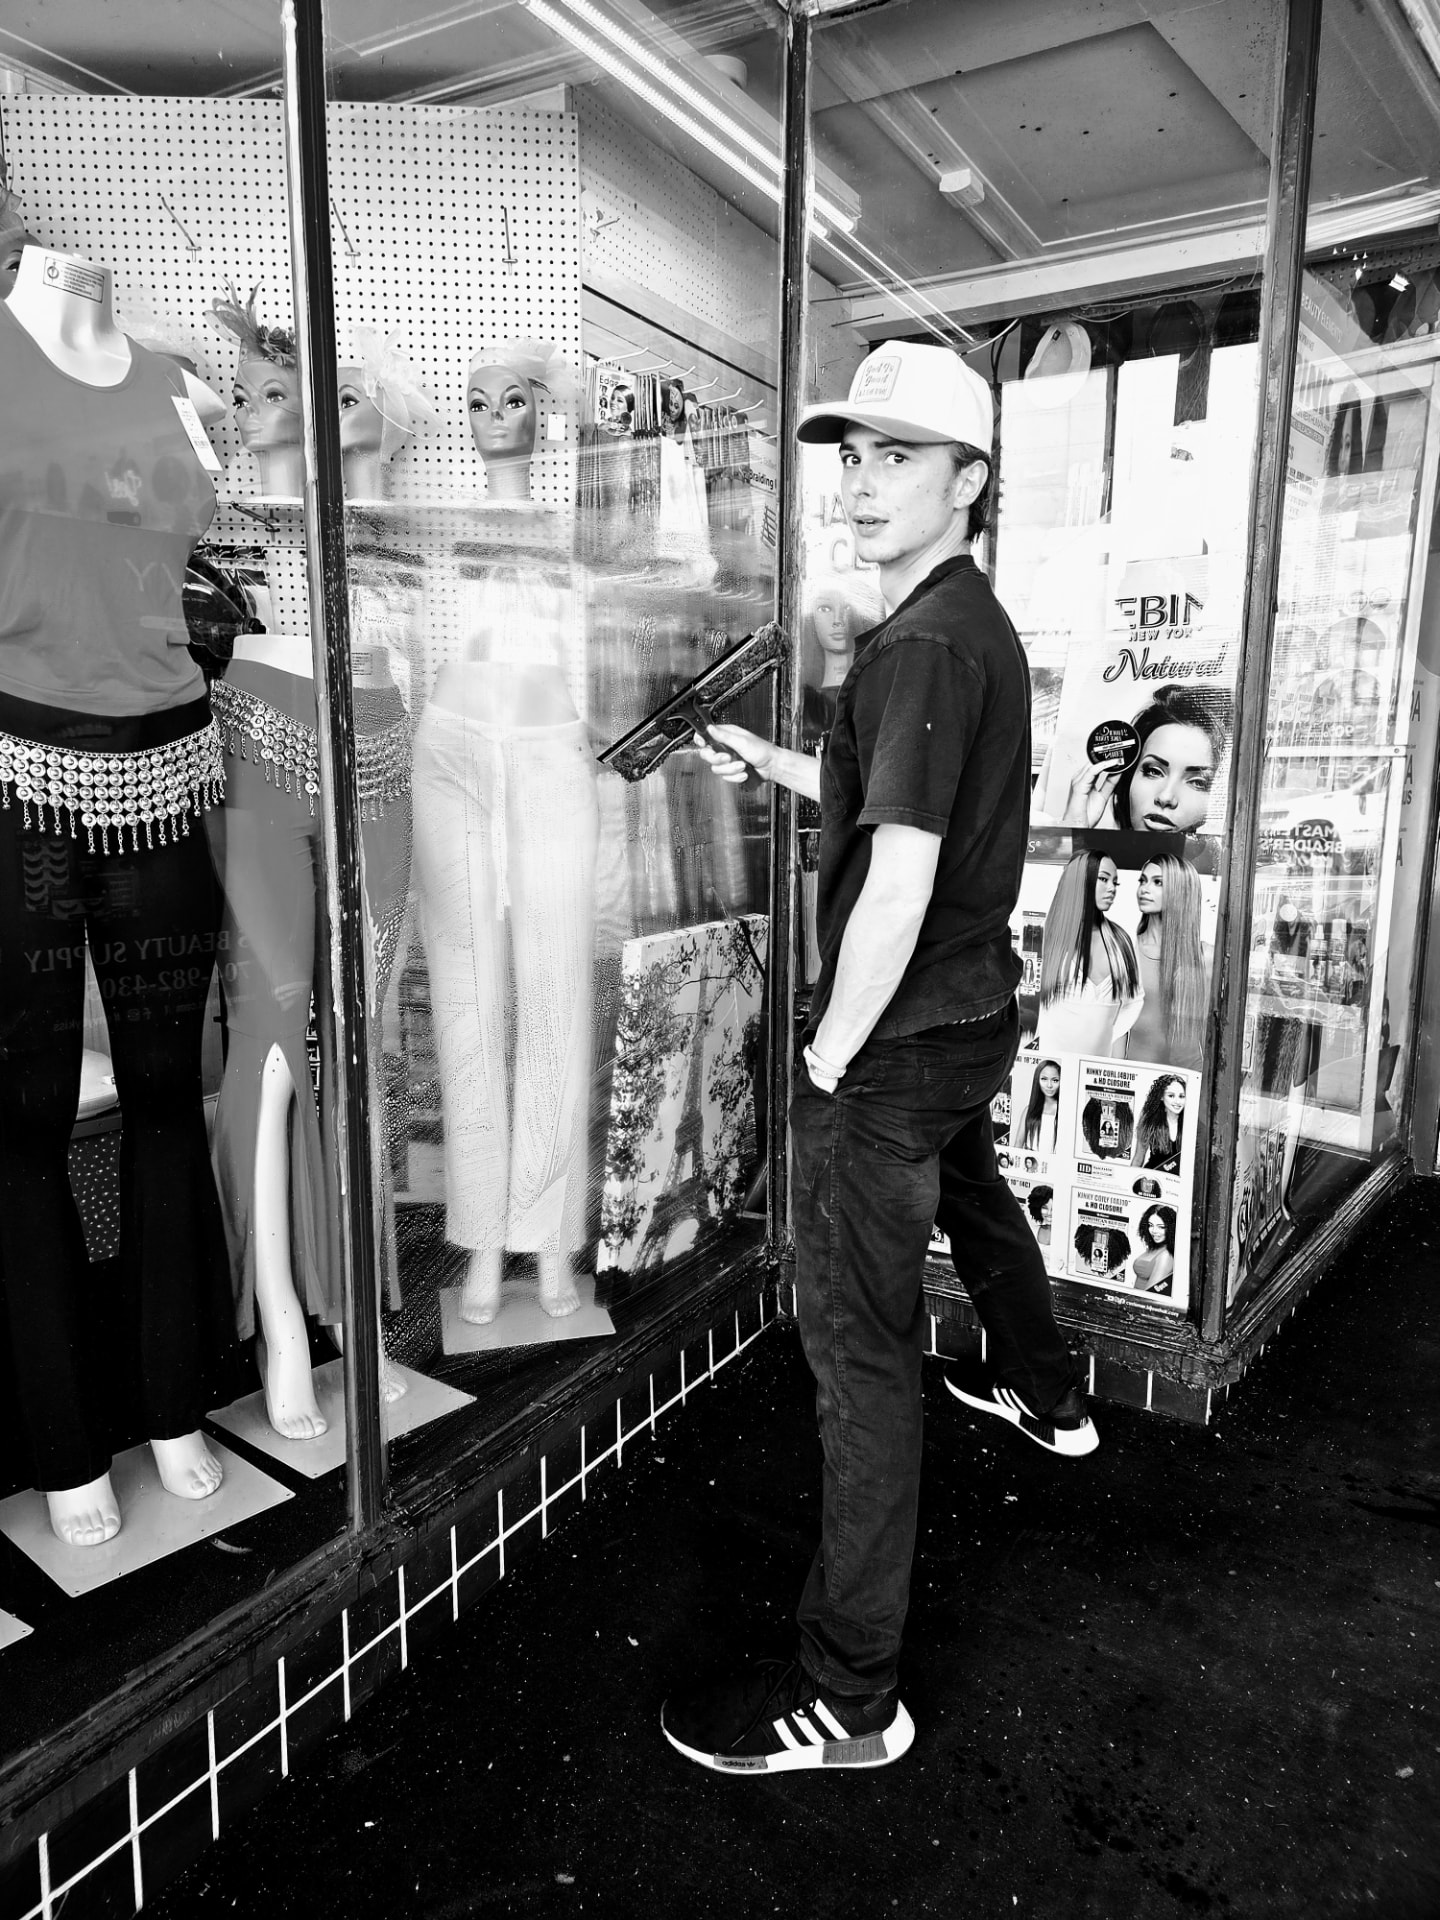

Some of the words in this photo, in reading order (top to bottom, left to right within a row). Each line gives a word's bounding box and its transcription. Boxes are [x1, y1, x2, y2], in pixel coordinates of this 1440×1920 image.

[1128, 629, 1160, 642] NEW
[1165, 626, 1203, 640] YOR
[1102, 642, 1230, 683] Natural
[1086, 1067, 1102, 1077] KINKY
[1102, 1069, 1117, 1079] CURL
[1107, 1079, 1130, 1089] CLOSURE
[1077, 1190, 1093, 1200] KINKY
[1098, 1203, 1123, 1213] CLOSURE
